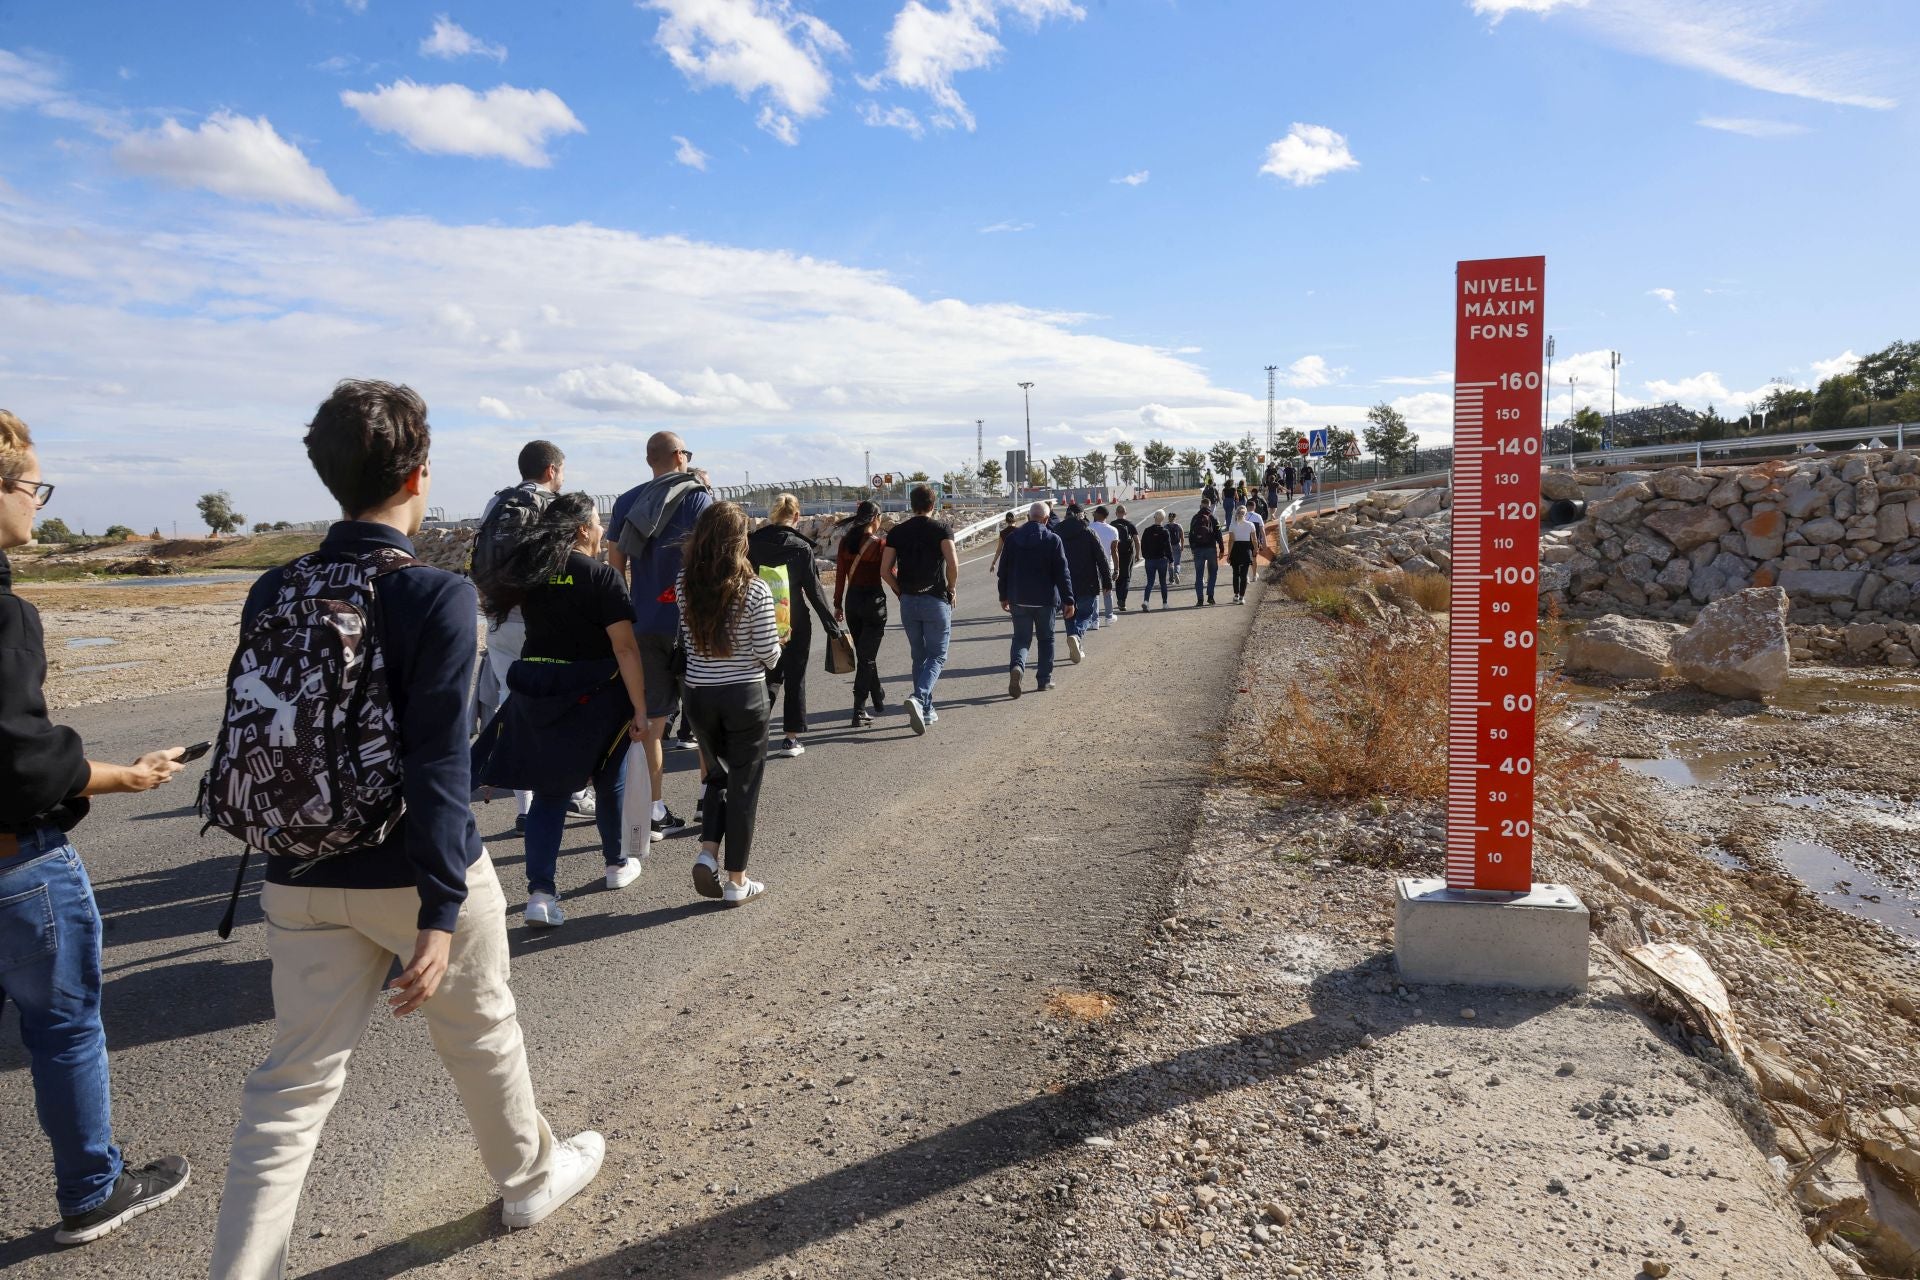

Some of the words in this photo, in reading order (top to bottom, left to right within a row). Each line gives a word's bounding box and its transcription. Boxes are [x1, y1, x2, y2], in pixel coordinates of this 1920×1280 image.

[1464, 277, 1537, 294] NIVELL
[1465, 298, 1535, 317] MÁXIM
[1470, 322, 1529, 340] FONS
[1500, 371, 1540, 391] 160
[1496, 408, 1520, 420] 150
[1497, 437, 1538, 455] 140
[1494, 473, 1519, 485] 130
[1497, 502, 1537, 520] 120
[1493, 538, 1514, 549] 110
[1494, 566, 1535, 585] 100
[1492, 602, 1510, 613] 90
[1503, 630, 1534, 649] 80
[1491, 665, 1508, 677] 70
[1503, 694, 1533, 712] 60
[1489, 728, 1508, 740] 50
[1499, 757, 1532, 775] 40
[1488, 791, 1507, 802] 30
[1500, 819, 1530, 838] 20
[1487, 852, 1502, 863] 10
